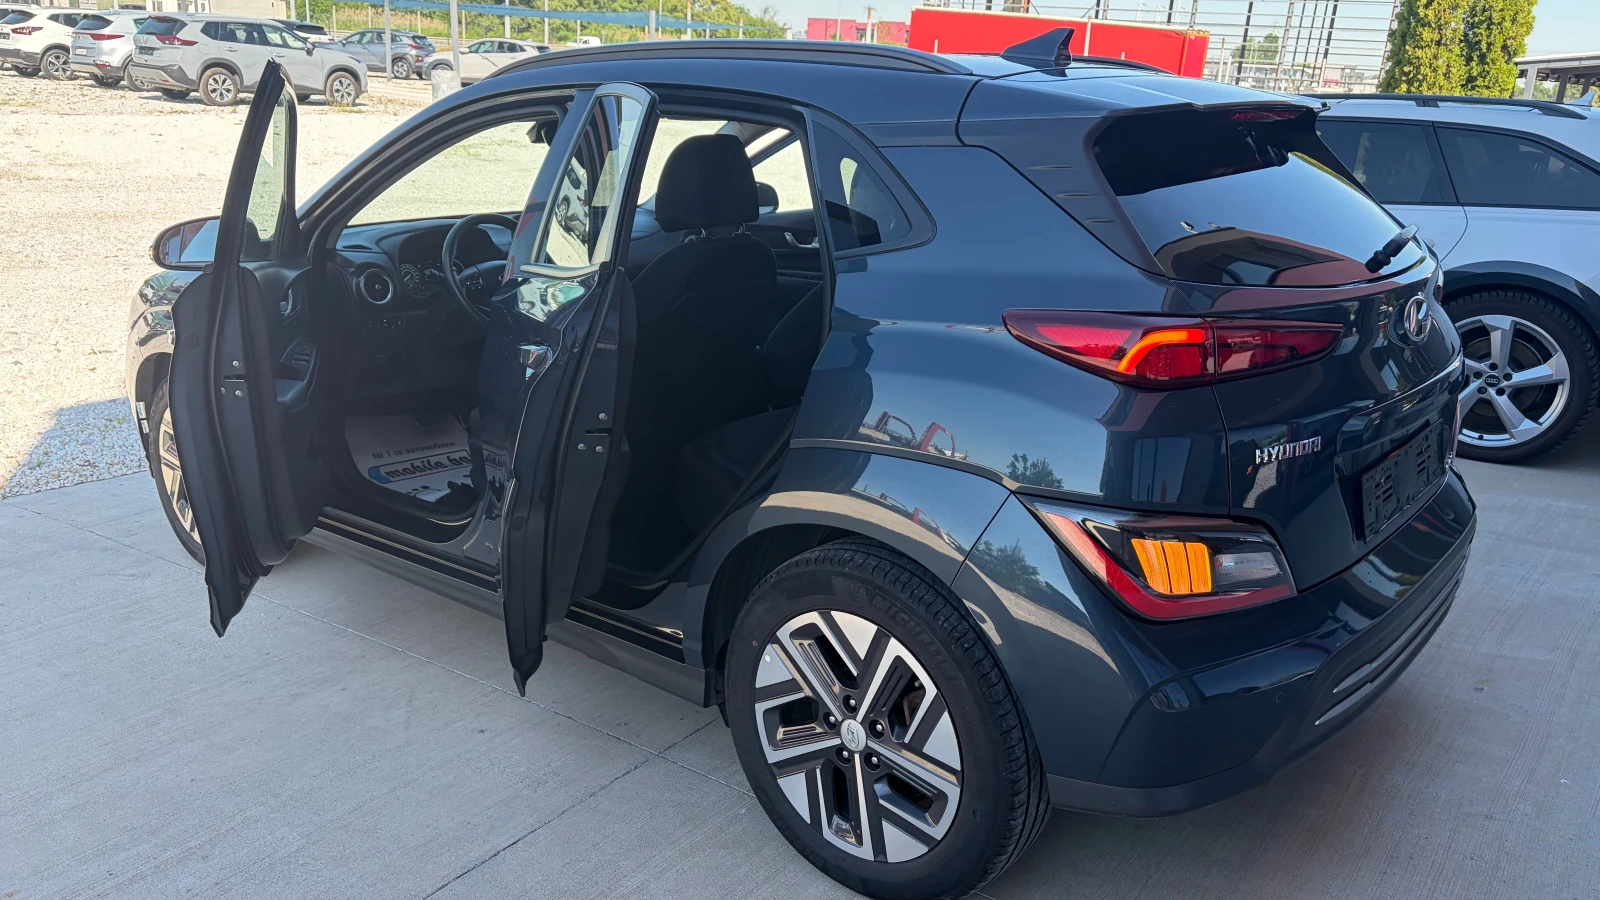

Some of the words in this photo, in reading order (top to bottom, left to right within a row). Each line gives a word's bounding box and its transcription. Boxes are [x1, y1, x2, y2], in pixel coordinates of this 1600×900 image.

[405, 441, 456, 455] автомобили
[1255, 436, 1321, 464] HYUNDAI
[385, 455, 472, 478] mobile.bg
